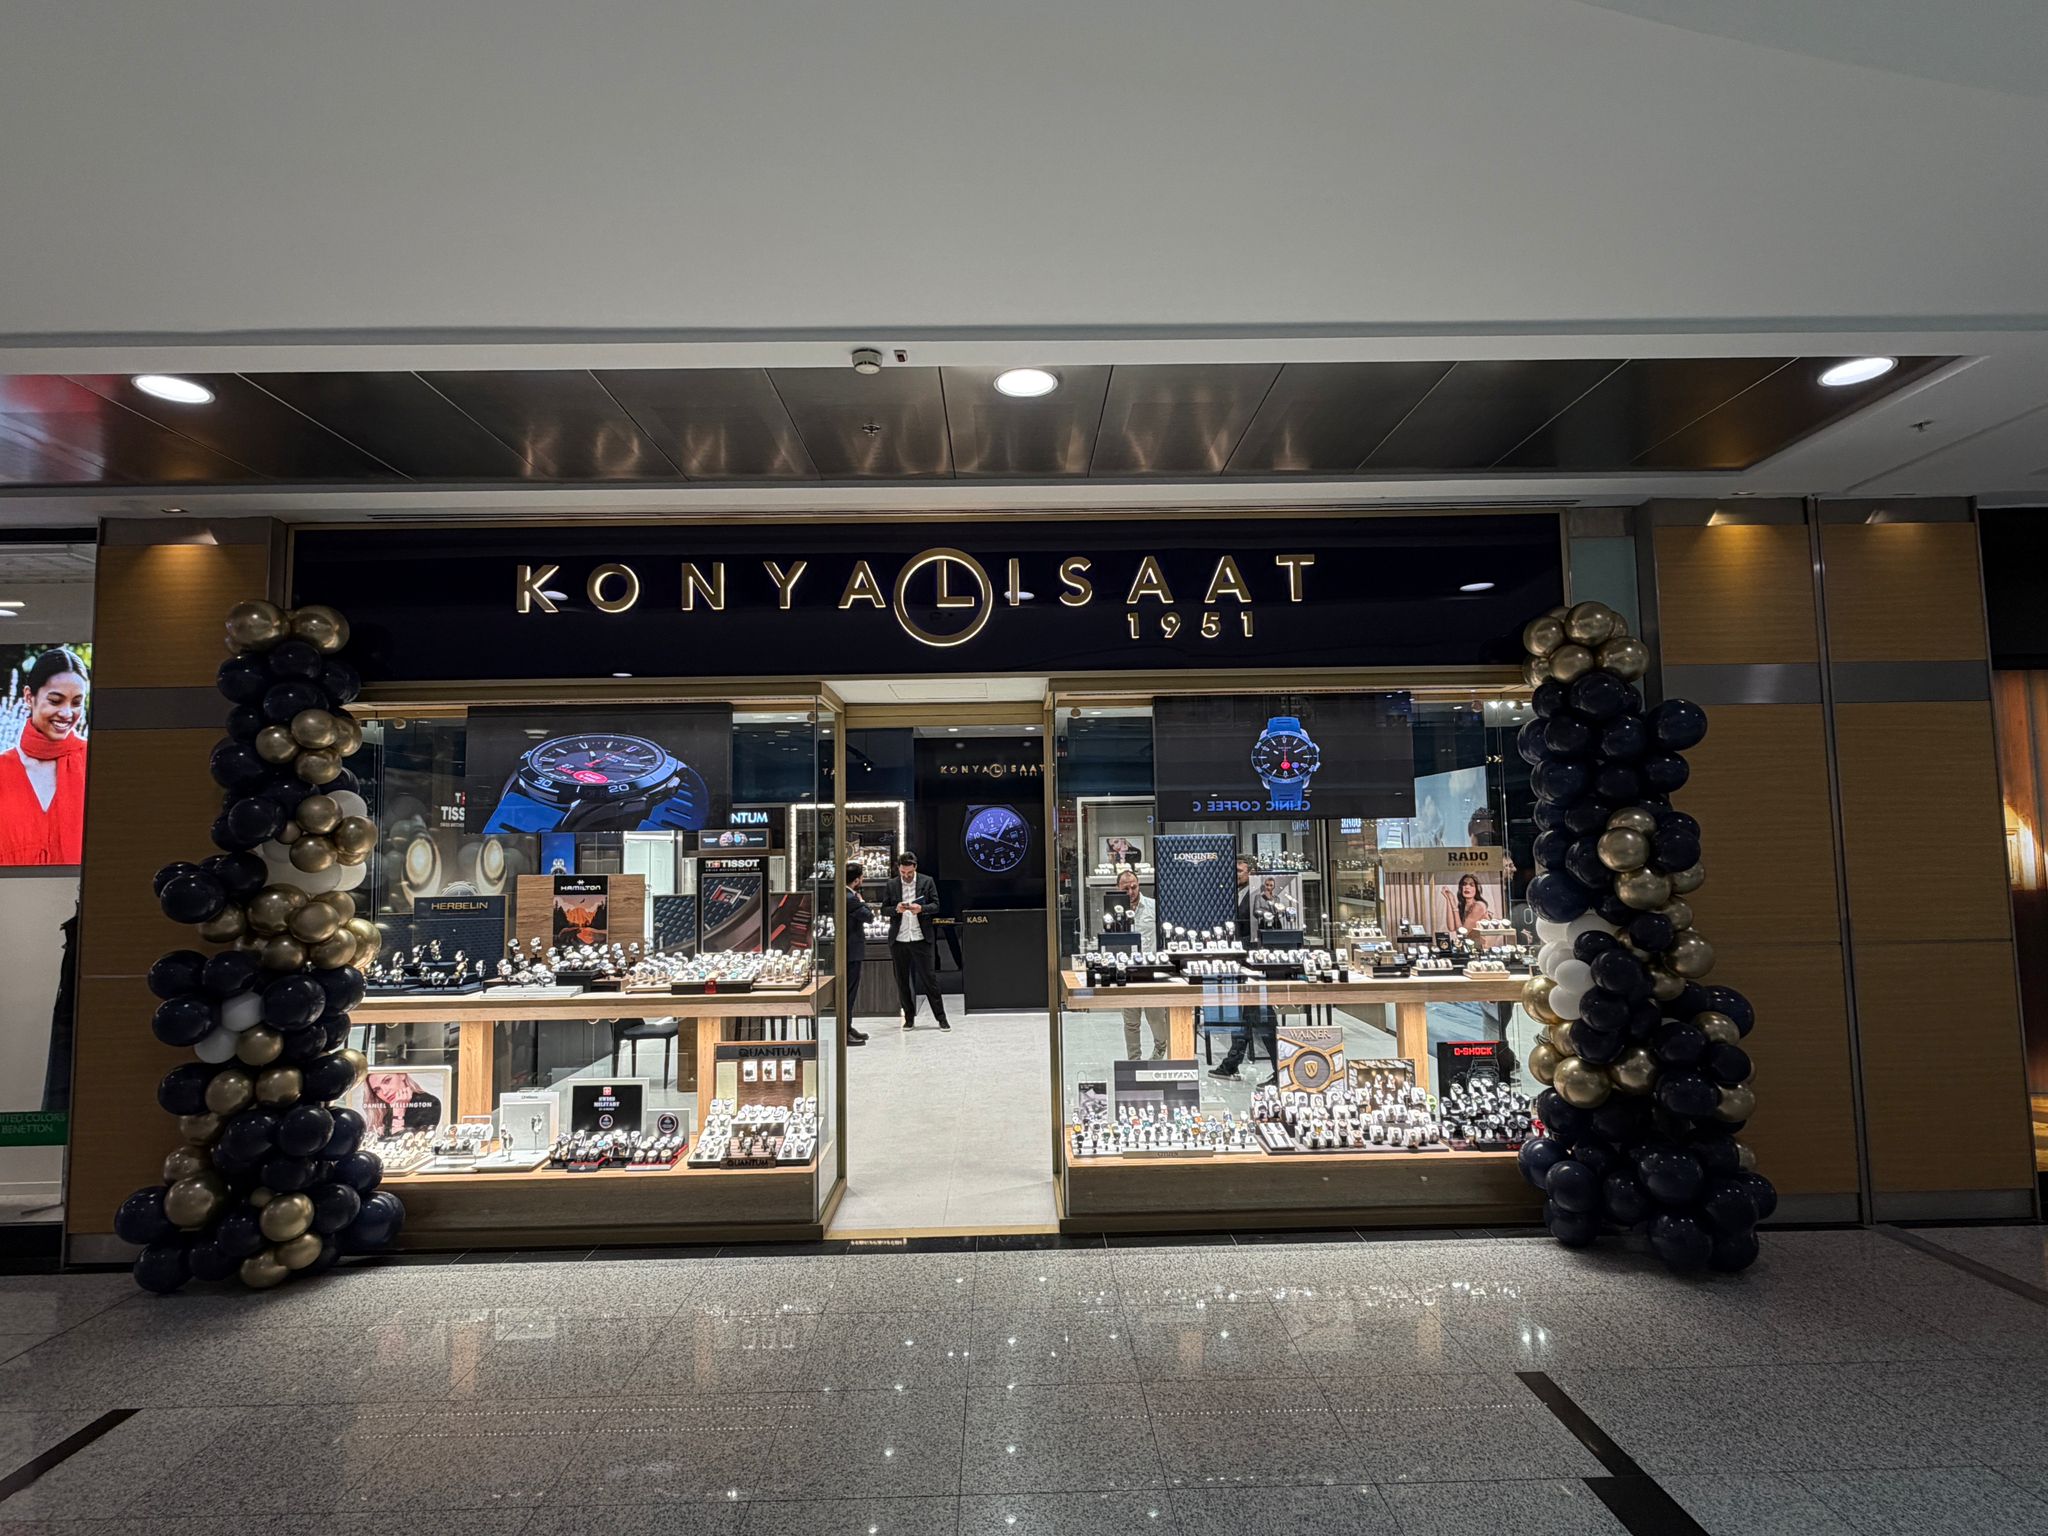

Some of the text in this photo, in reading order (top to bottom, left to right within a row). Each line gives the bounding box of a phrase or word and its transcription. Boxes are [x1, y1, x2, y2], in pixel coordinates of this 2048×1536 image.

[516, 547, 1316, 648] KONYALI SAAT
[1126, 611, 1255, 639] 1951
[534, 776, 553, 788] 30
[608, 783, 630, 793] 20
[441, 806, 465, 821] TISS
[731, 811, 769, 824] NTUM
[845, 814, 875, 823] AINER
[1173, 852, 1218, 861] LONGINES
[1447, 851, 1489, 862] RADO
[721, 859, 760, 868] TISSOT
[431, 901, 489, 911] HERBELIN
[966, 916, 989, 924] KASA
[1288, 1029, 1332, 1040] WAINER
[738, 1047, 802, 1057] QUANTUM
[1454, 1047, 1493, 1056] G-SHOCK
[1152, 1070, 1197, 1080] CITIZEN
[0, 1113, 23, 1124] ITED
[2, 1124, 54, 1135] BENETTON
